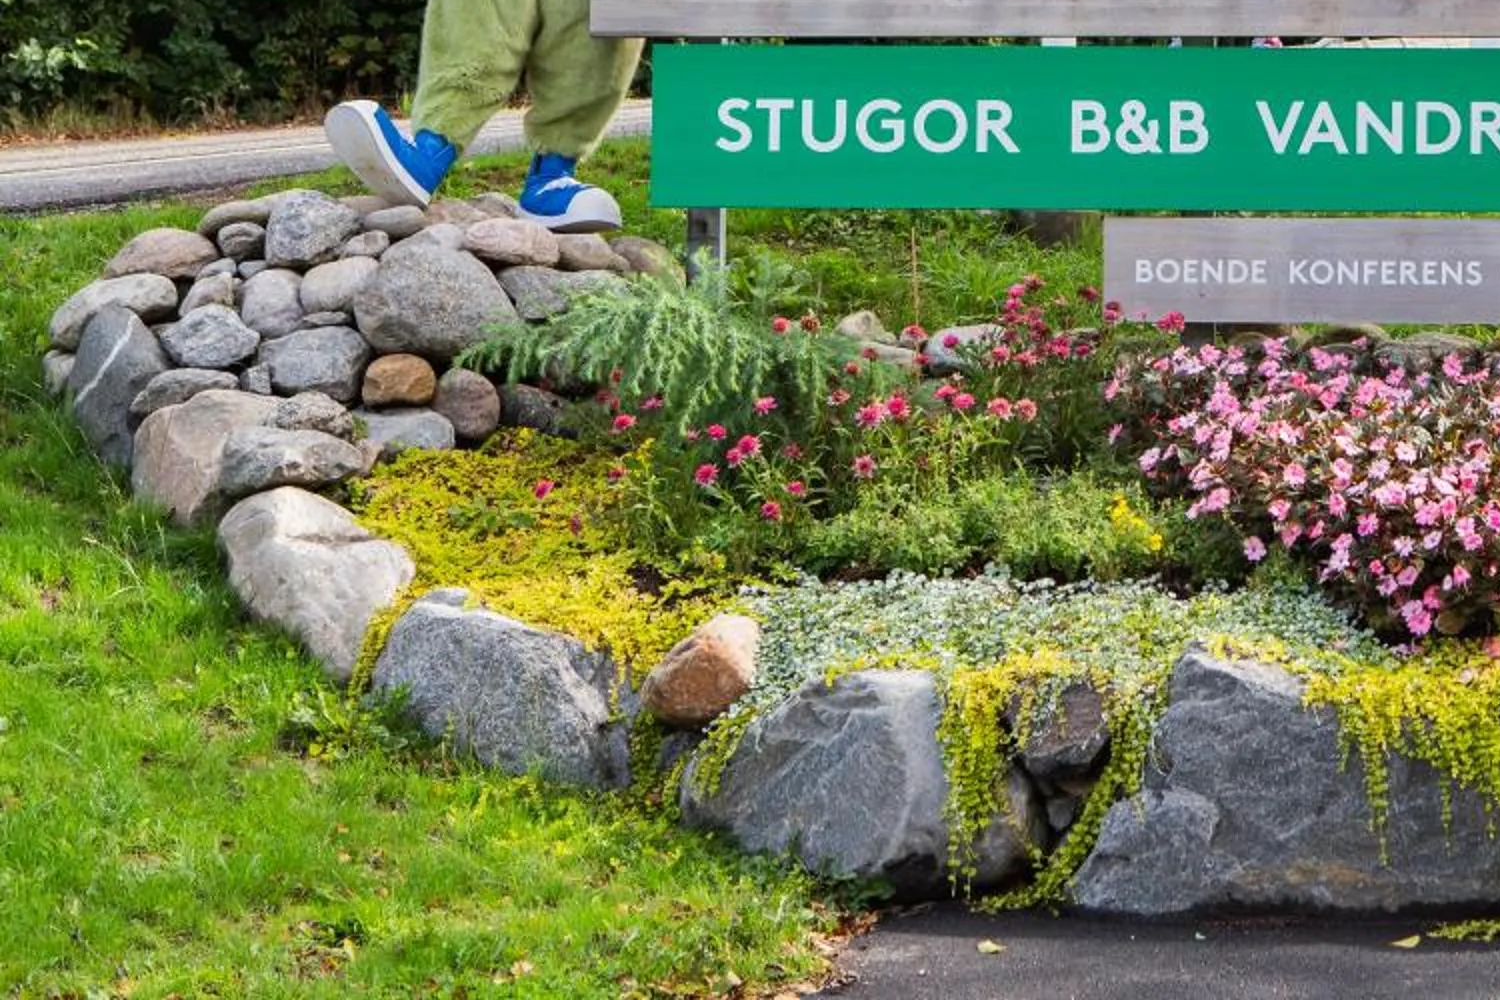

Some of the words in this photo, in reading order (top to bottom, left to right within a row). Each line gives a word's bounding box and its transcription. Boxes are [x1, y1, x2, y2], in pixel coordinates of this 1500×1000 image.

[715, 97, 1020, 154] STUGOR
[1070, 99, 1209, 155] B&B
[1134, 258, 1268, 285] BOENDE
[1288, 258, 1483, 287] KONFERENS
